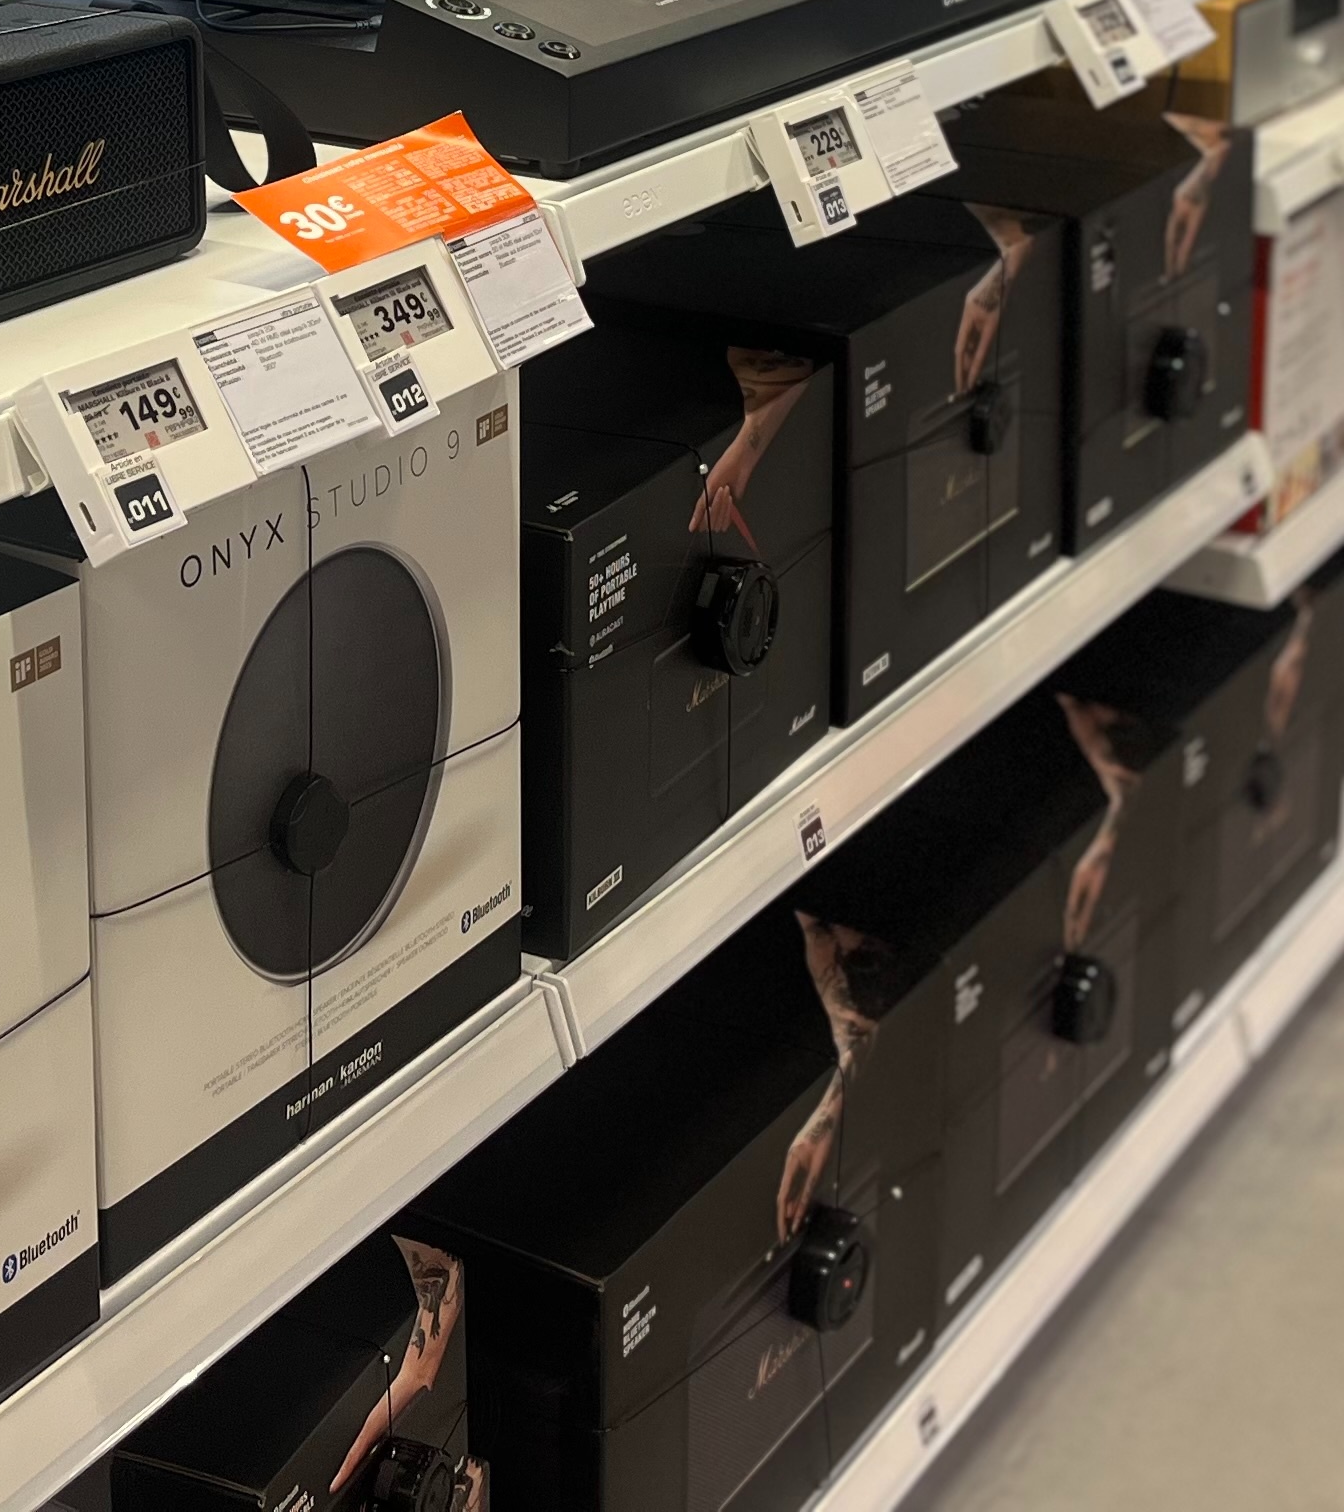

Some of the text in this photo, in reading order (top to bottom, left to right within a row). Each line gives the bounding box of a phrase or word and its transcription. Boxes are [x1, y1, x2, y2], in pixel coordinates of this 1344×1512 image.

[810, 127, 843, 156] 229
[279, 203, 347, 240] 30
[374, 293, 426, 333] 349
[119, 387, 178, 431] 149
[178, 404, 195, 421] 99
[391, 383, 426, 413] 012
[105, 459, 157, 486] LIBRE SERVICE
[110, 457, 133, 472] Article
[128, 490, 168, 522] 011
[180, 513, 286, 588] ONYX
[305, 445, 428, 531] STUDIO
[446, 429, 460, 460] 9
[589, 552, 631, 591] 50+ HOURS
[589, 562, 638, 607] OF PORTABLE
[589, 586, 626, 623] PLAYTIME
[806, 828, 825, 853] 013
[472, 883, 512, 924] Bluetooth
[340, 1040, 383, 1082] kardon
[344, 1053, 383, 1087] HARMAN
[18, 1215, 79, 1270] Bluetooth
